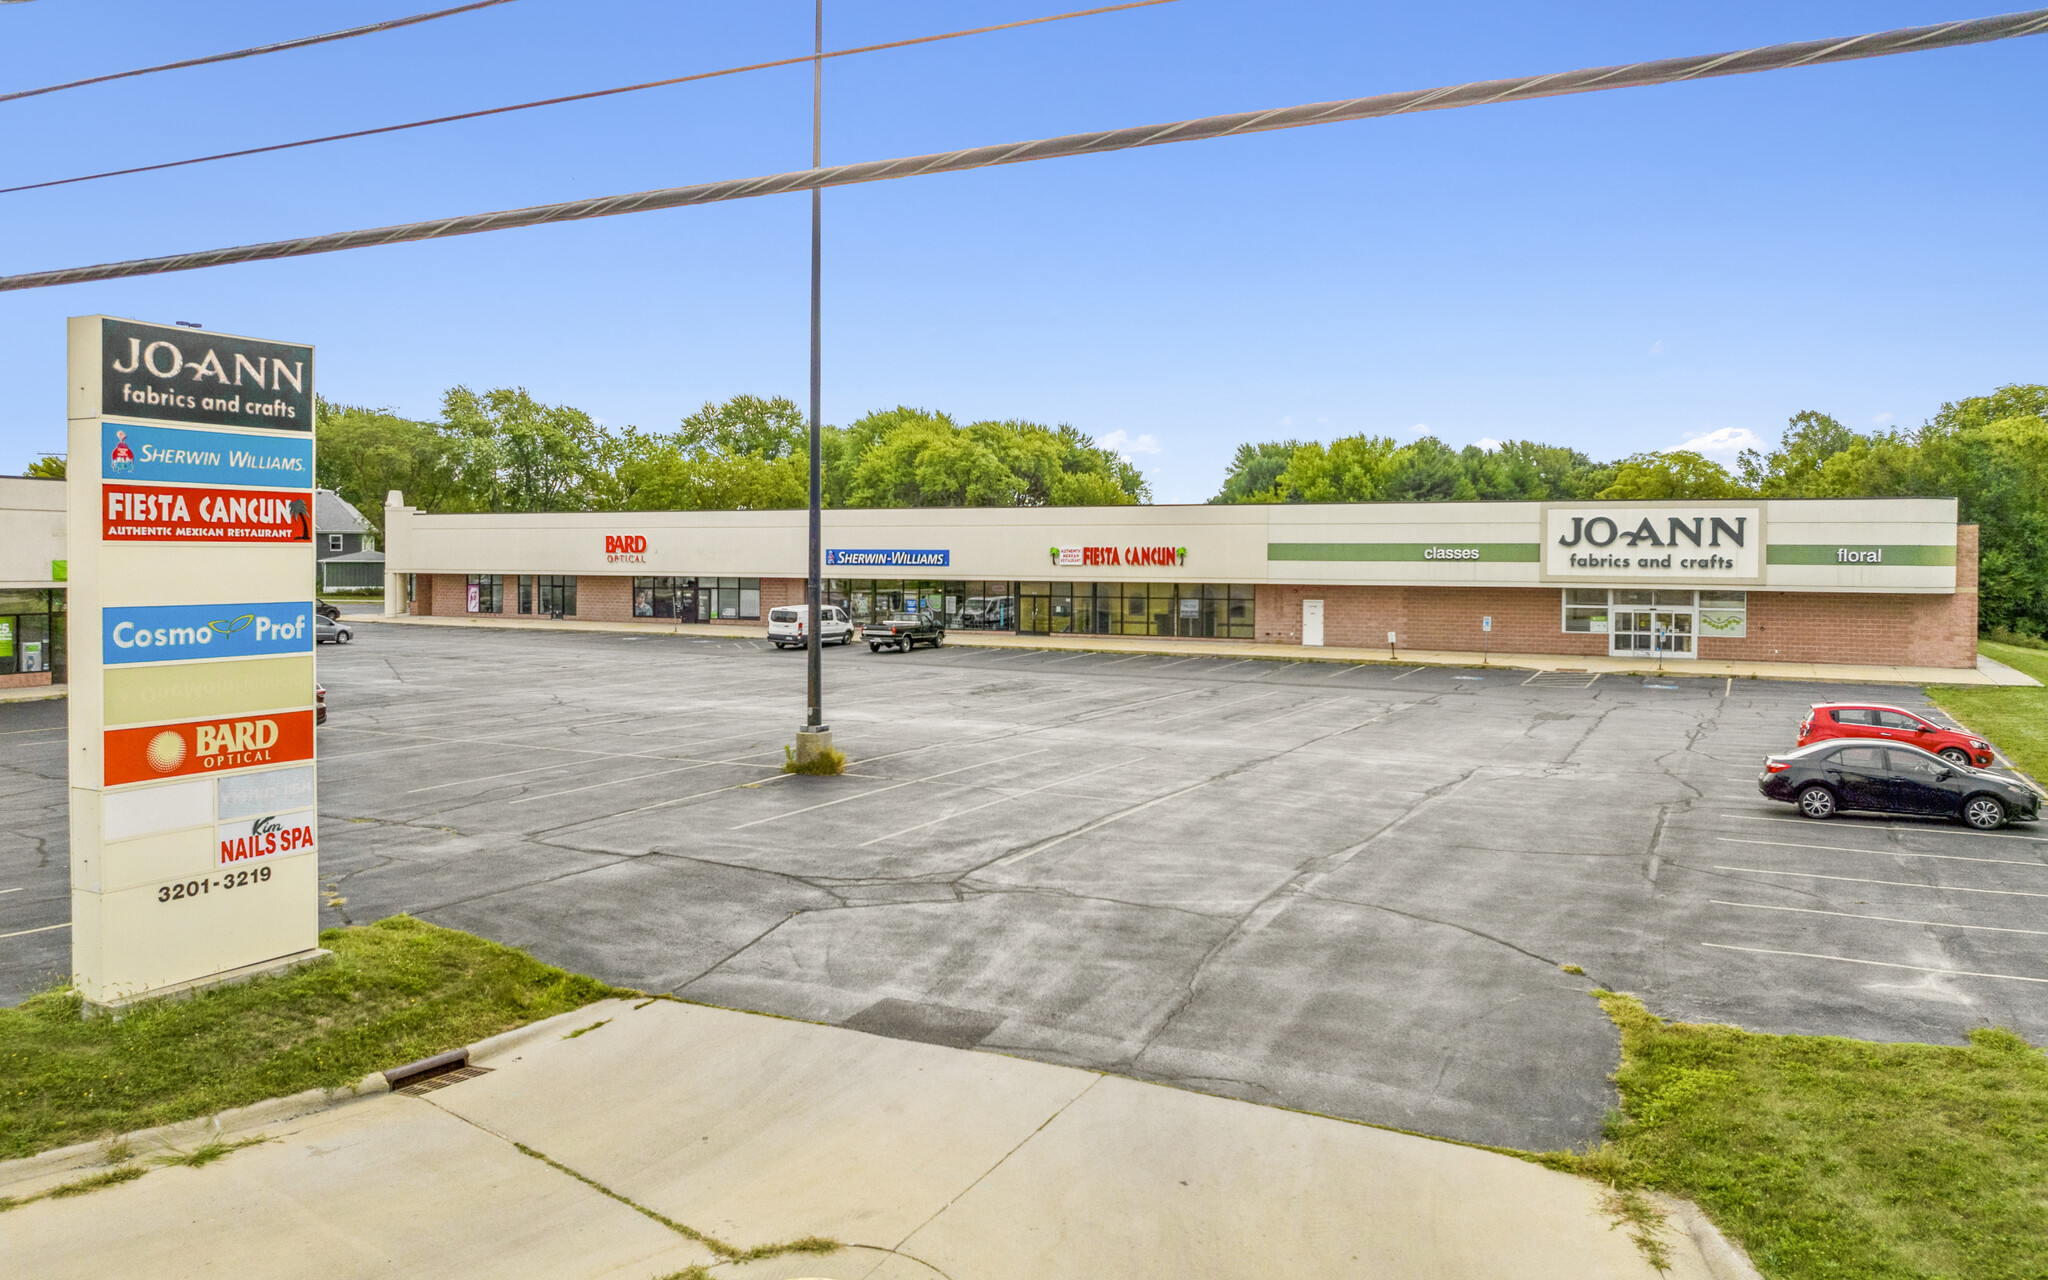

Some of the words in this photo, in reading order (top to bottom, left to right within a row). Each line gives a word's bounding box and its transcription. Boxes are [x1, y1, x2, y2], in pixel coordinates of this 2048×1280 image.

[122, 383, 197, 409] fabrics
[202, 394, 240, 413] and
[245, 399, 296, 418] crafts
[140, 444, 221, 467] SHERWIN
[229, 450, 304, 472] WILLIAMS
[108, 492, 191, 522] FIESTA
[199, 496, 292, 524] CANCUN
[108, 526, 172, 536] AUTHENTIC
[175, 528, 224, 537] MEXICAN
[227, 528, 293, 538] RESTAURANT
[605, 535, 647, 553] BARD
[606, 554, 647, 564] OPTICAL
[837, 551, 945, 565] SHERWIN-WILLIAMS
[1083, 547, 1120, 566] FIESTA
[1125, 547, 1176, 565] CANCUN
[1423, 546, 1480, 561] classes
[1569, 552, 1630, 569] fabrics
[1637, 553, 1672, 569] and
[1680, 553, 1733, 570] crafts
[1836, 547, 1882, 564] floral
[113, 621, 213, 649] Cosmo
[255, 614, 305, 641] Prof
[196, 720, 279, 757] BARD
[203, 750, 271, 768] OPTICAL
[252, 816, 283, 836] Kim
[221, 832, 276, 863] NAILS
[280, 825, 313, 852] SPA
